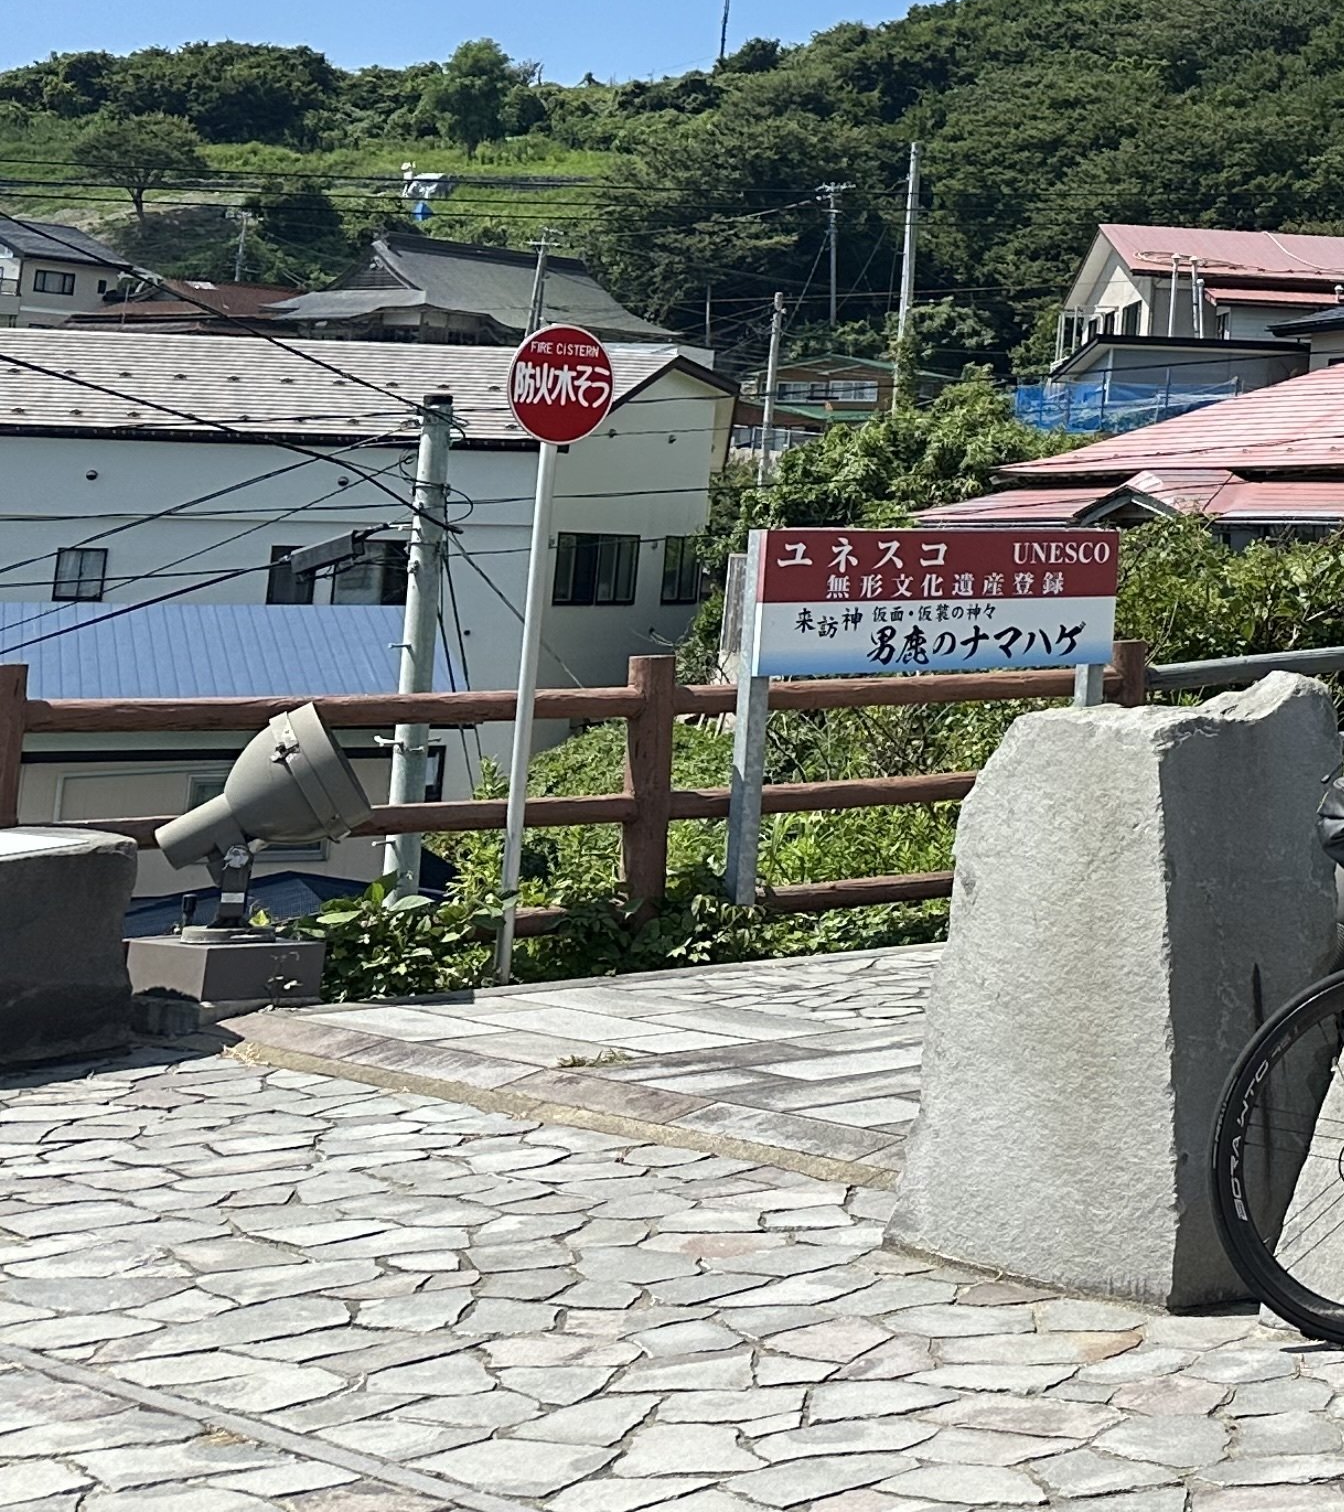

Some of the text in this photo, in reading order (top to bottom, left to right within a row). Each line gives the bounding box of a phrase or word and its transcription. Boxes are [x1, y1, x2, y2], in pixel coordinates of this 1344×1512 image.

[530, 341, 553, 355] FIRE
[776, 537, 1112, 574] ユネスコ UNESCO
[825, 571, 1065, 600] 無形文化遺産登録
[794, 607, 864, 639] 来訪神
[866, 620, 1087, 666] 男鹿のナマハゲ
